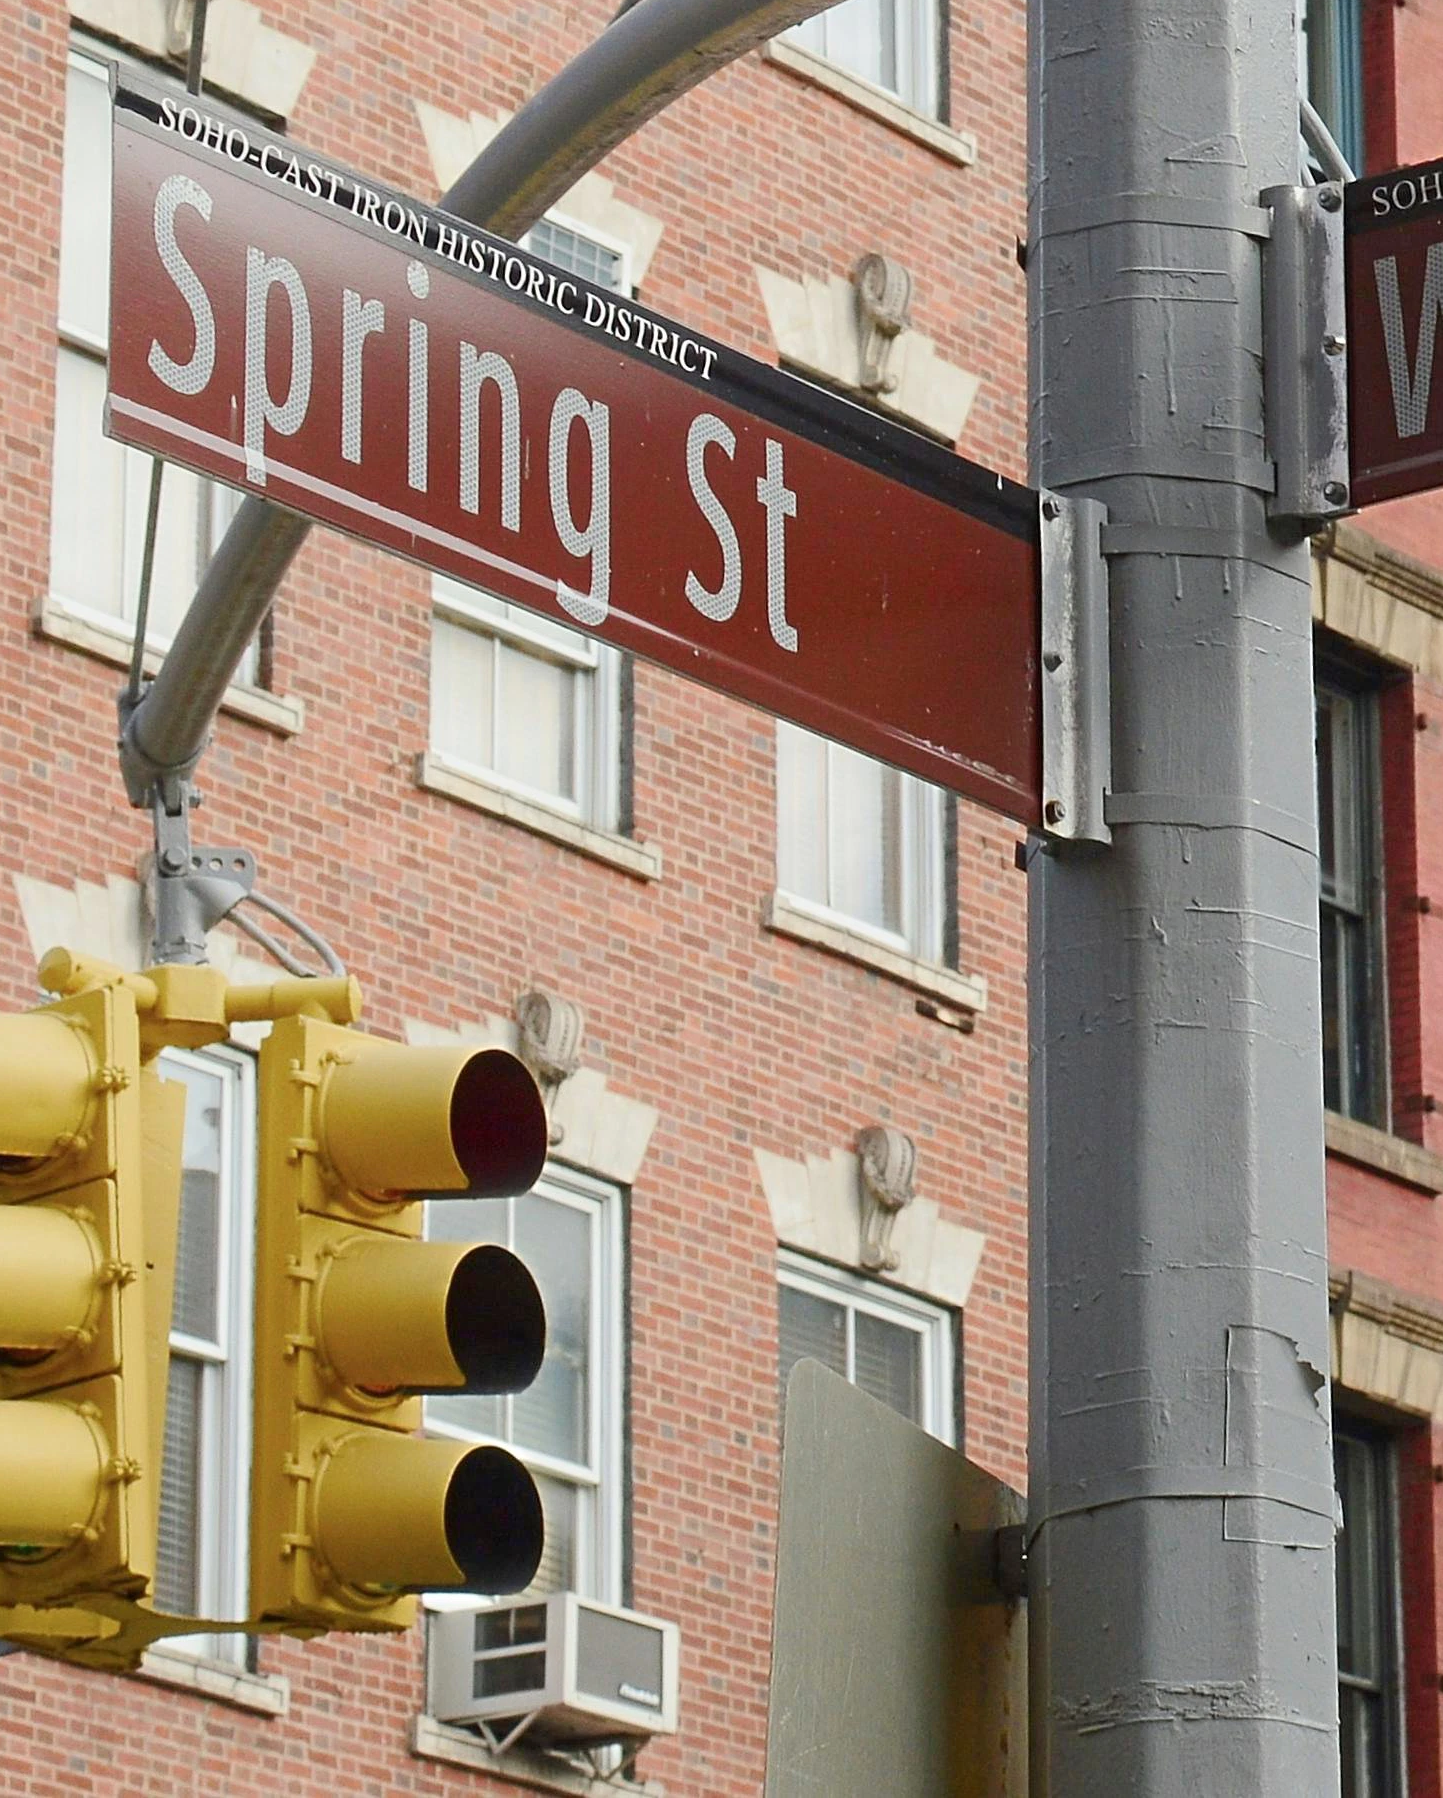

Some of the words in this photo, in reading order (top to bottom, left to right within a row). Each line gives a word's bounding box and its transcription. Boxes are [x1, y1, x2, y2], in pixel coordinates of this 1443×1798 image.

[148, 174, 612, 627] Spring
[685, 413, 799, 653] St
[158, 98, 344, 205] SOHO-CAST
[351, 184, 429, 247] IRON
[436, 223, 578, 315] HISTORIC
[583, 292, 718, 380] DISTRICT
